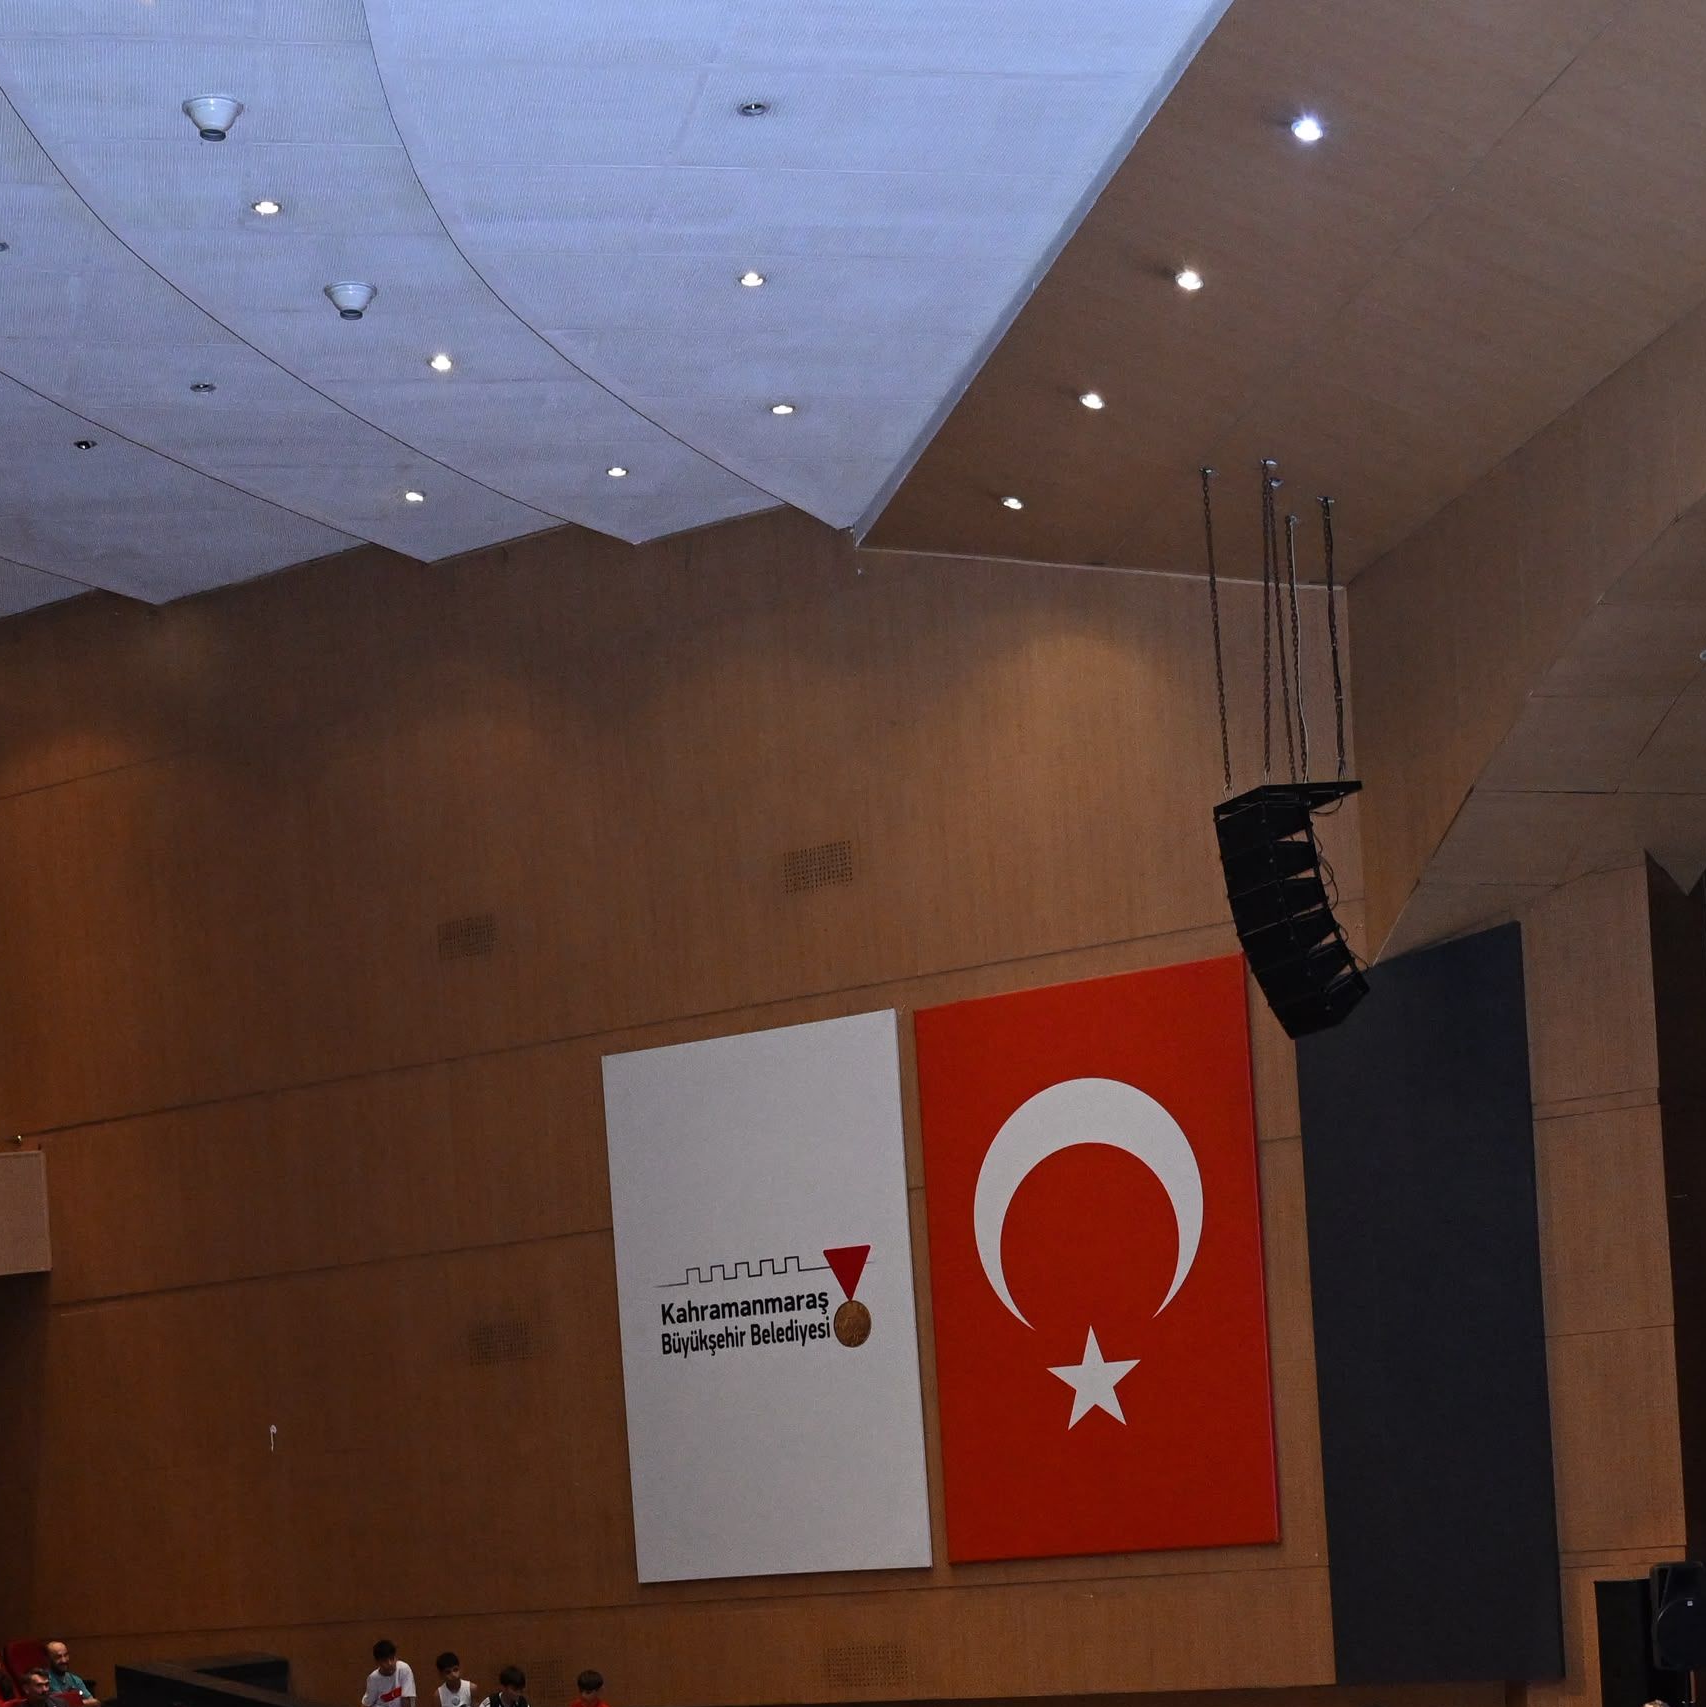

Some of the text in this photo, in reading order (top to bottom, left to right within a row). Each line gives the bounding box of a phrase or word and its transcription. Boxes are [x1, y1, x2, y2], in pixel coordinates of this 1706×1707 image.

[661, 1290, 830, 1325] Kahramanmaraş
[661, 1316, 831, 1358] Büyükşehir Belediyesi
